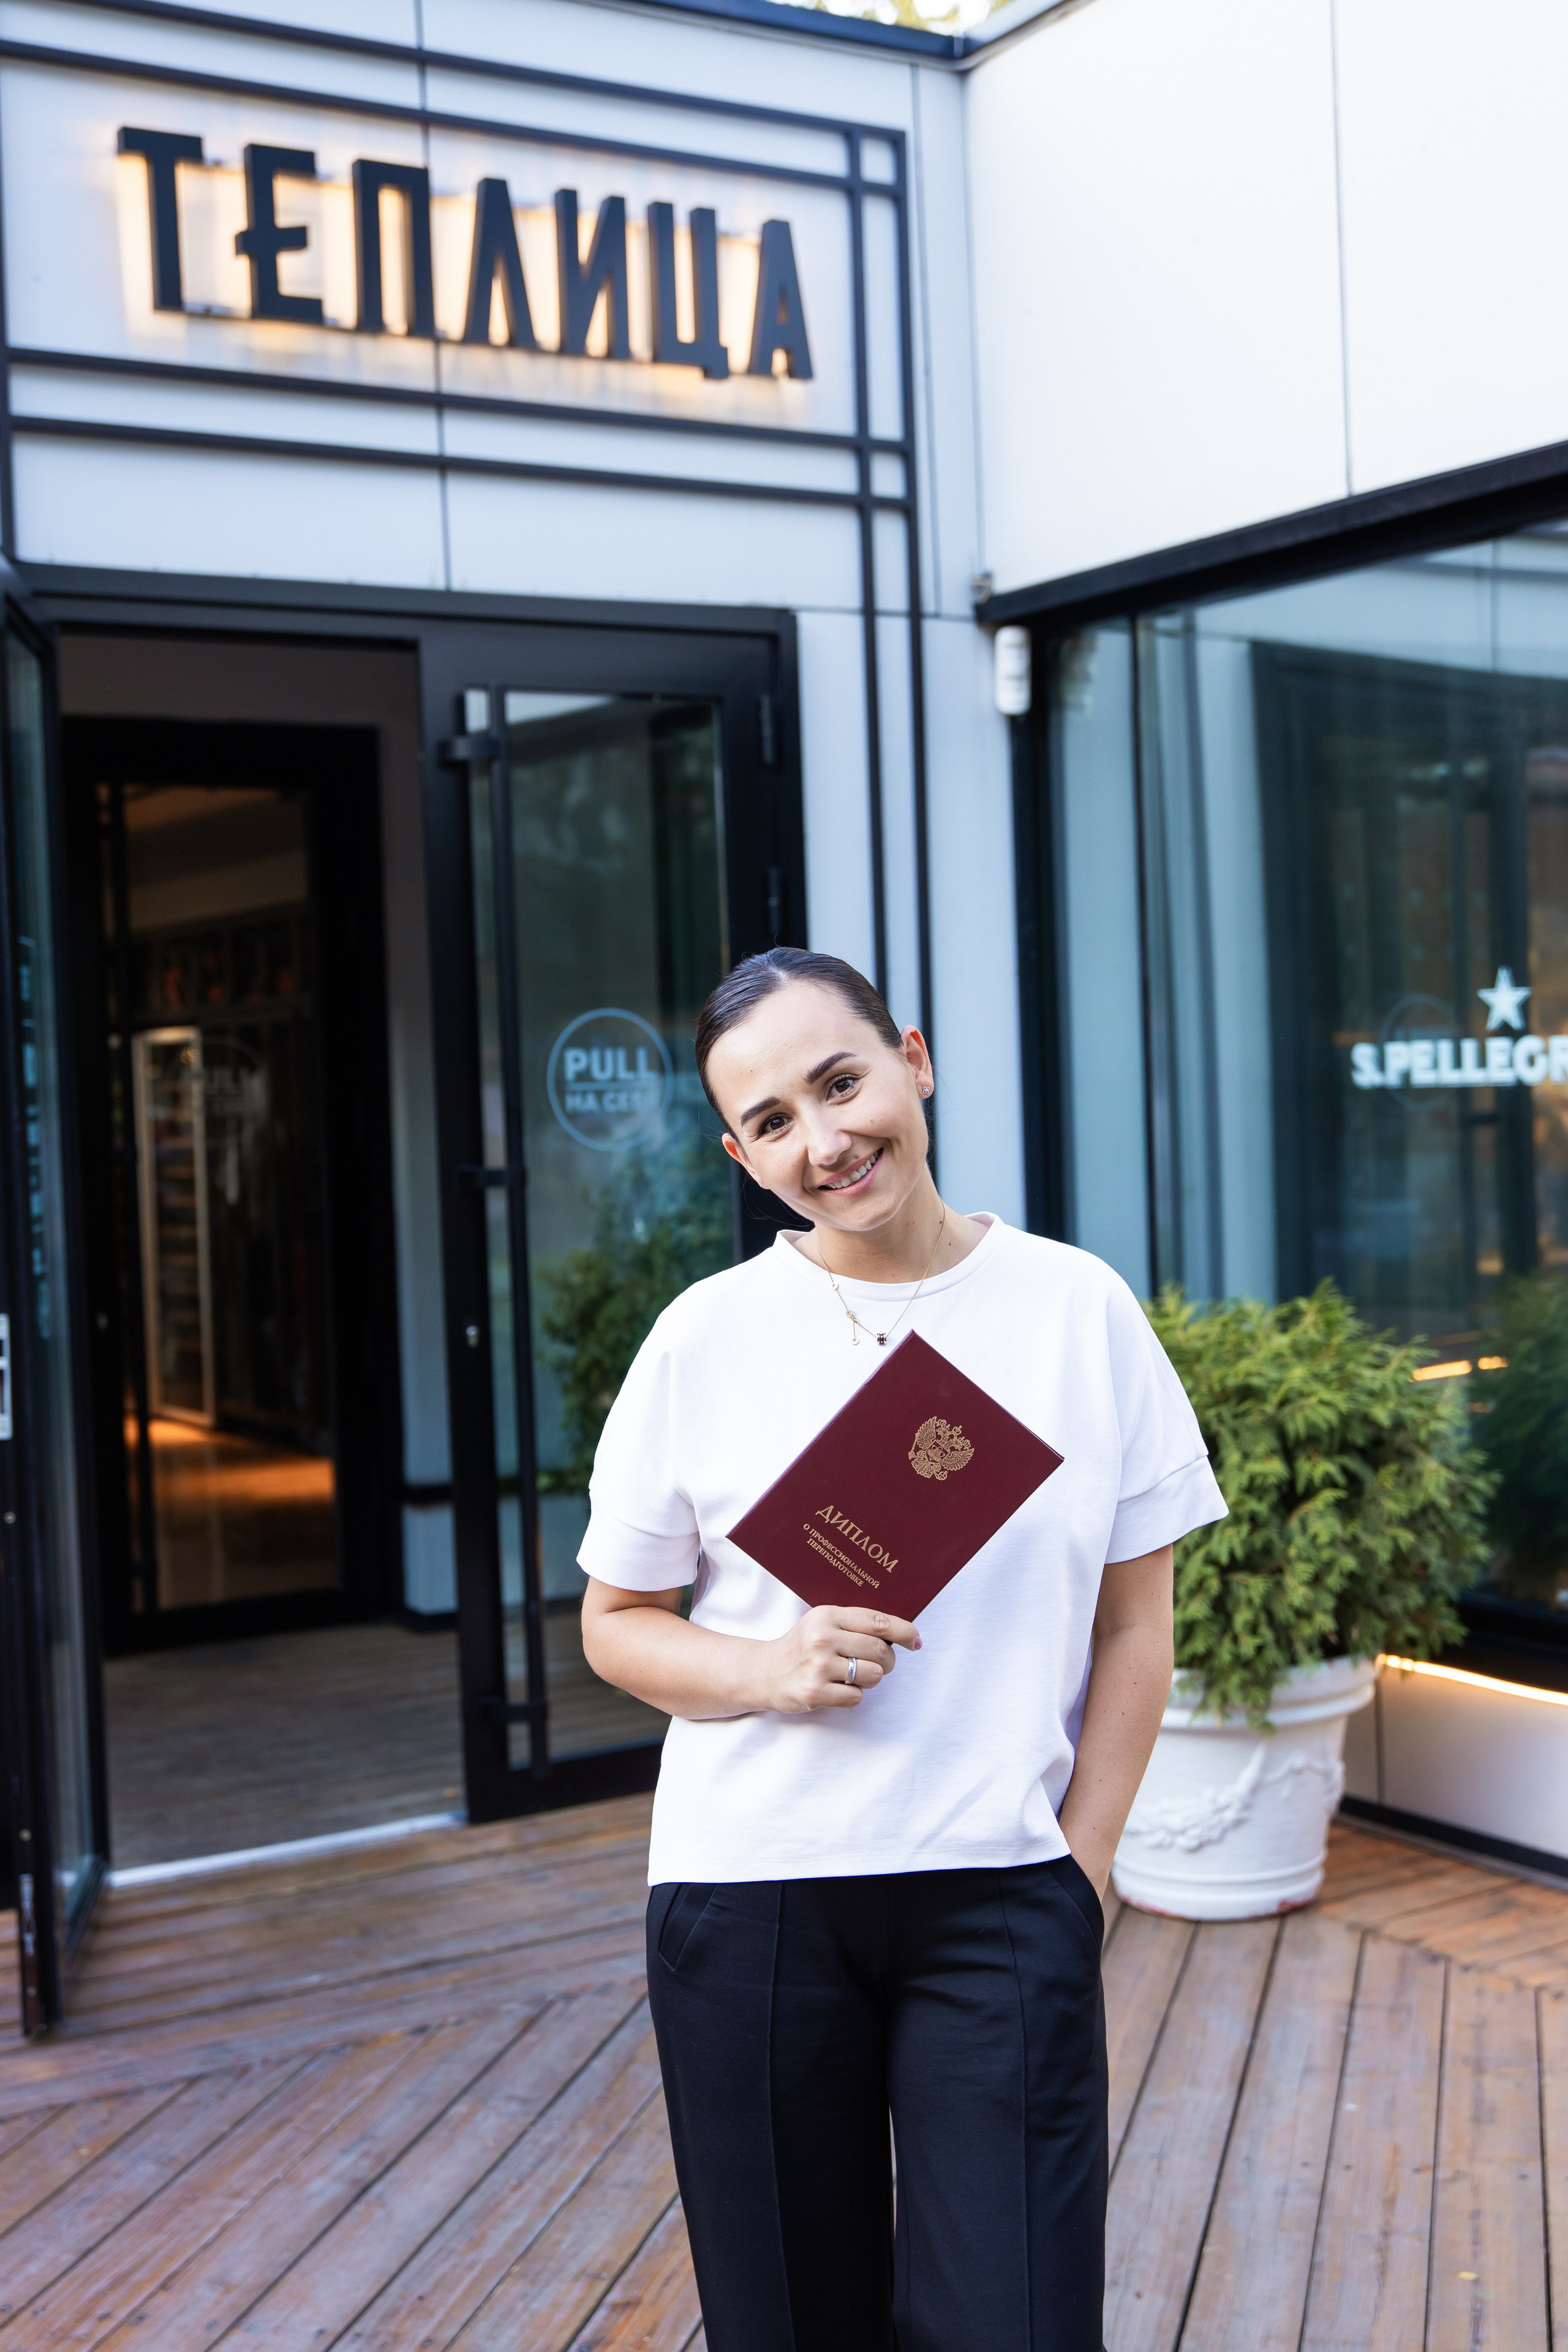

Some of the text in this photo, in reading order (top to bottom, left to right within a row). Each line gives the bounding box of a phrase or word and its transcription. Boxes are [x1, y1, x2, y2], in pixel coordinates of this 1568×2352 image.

[117, 126, 814, 380] ТЕПЛИЦА
[564, 1046, 660, 1080] PULL
[601, 1091, 660, 1112] СЕ
[807, 1538, 864, 1586] ПЕРЕПОДГОТОВКЕ
[809, 1528, 880, 1589] ПРОФЕССИОНАЛЬНОЙ
[815, 1505, 899, 1573] ДИПЛОМ
